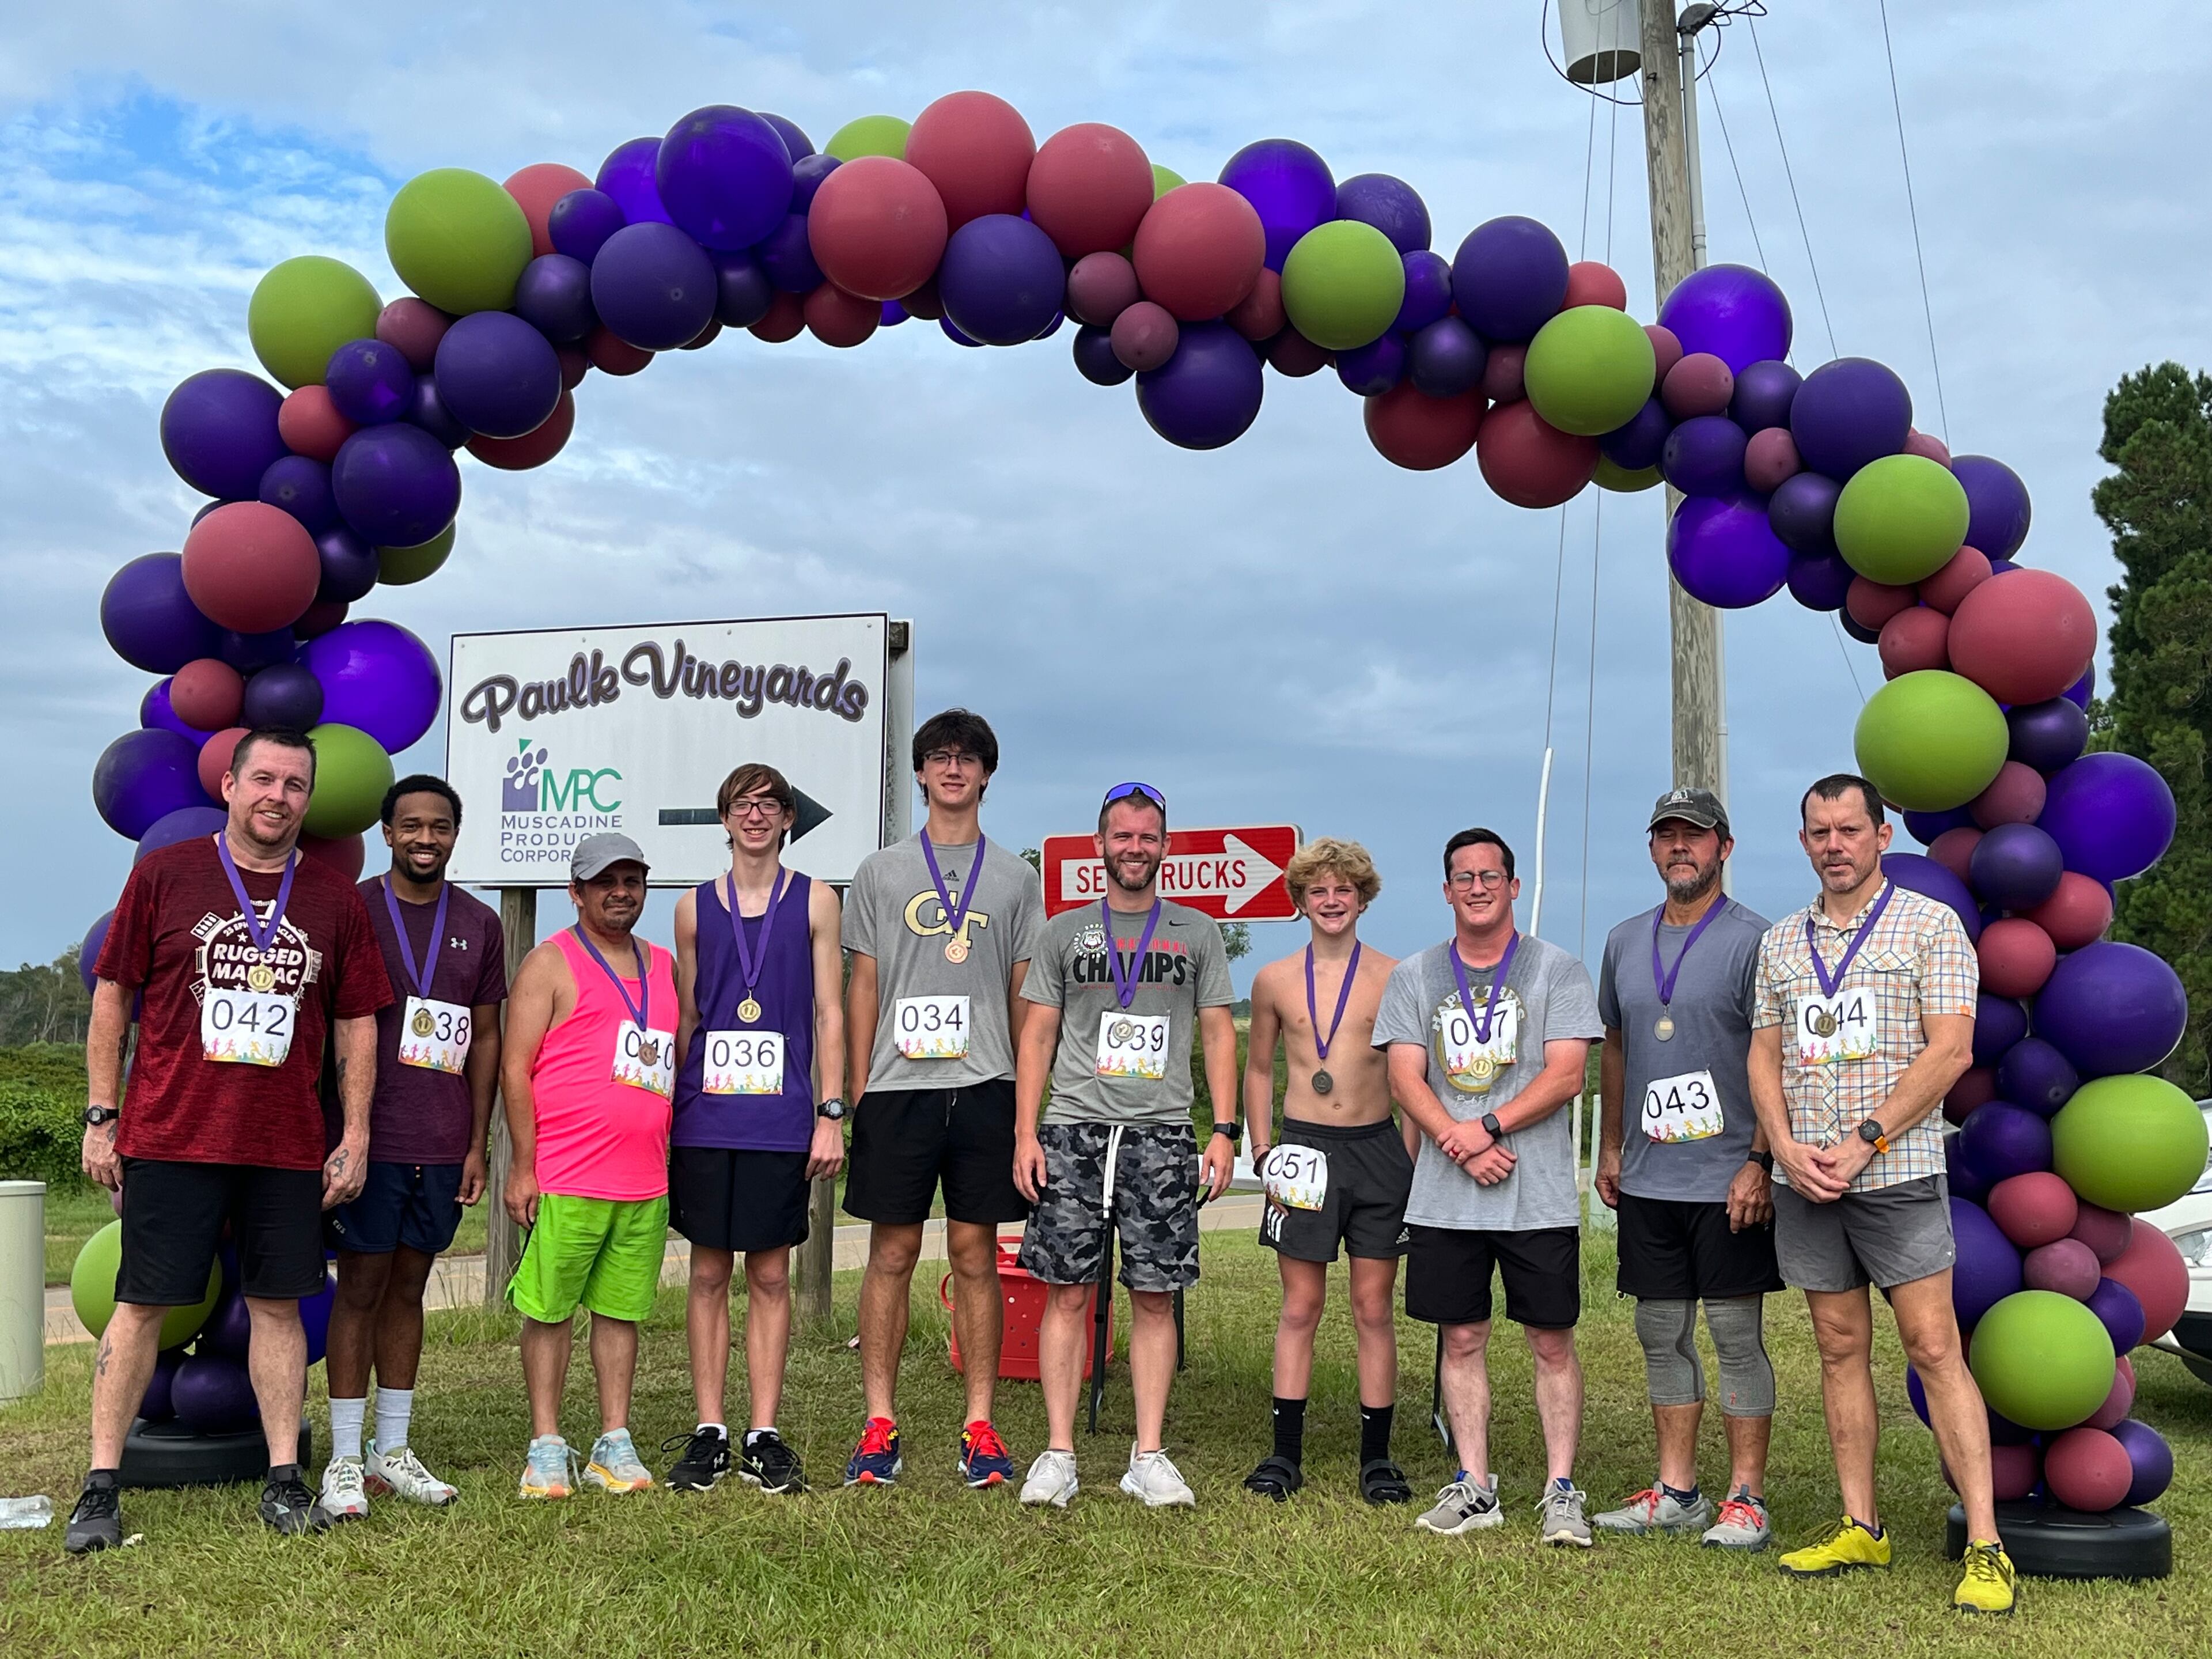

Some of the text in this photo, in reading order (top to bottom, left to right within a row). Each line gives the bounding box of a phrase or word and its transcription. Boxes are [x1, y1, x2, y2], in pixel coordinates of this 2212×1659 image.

[461, 638, 869, 733] Paulk Vineyards
[541, 768, 623, 813] MPC
[501, 815, 623, 830] MUSCADINE
[501, 832, 622, 846] PRODU
[501, 848, 571, 862] CORPOR
[1076, 859, 1247, 893] SE RUCKS
[213, 943, 303, 966] RUGGED
[1116, 937, 1188, 956] NAONAL
[211, 962, 300, 986] MAAC
[1073, 952, 1187, 986] CHAMPS
[211, 998, 288, 1037] 042
[414, 1007, 469, 1046] 38
[902, 1003, 963, 1032] 034
[1805, 997, 1868, 1035] 044
[1107, 1021, 1164, 1052] 039
[712, 1039, 775, 1067] 036
[1646, 1081, 1710, 1119] 043
[1267, 1152, 1318, 1184] 051
